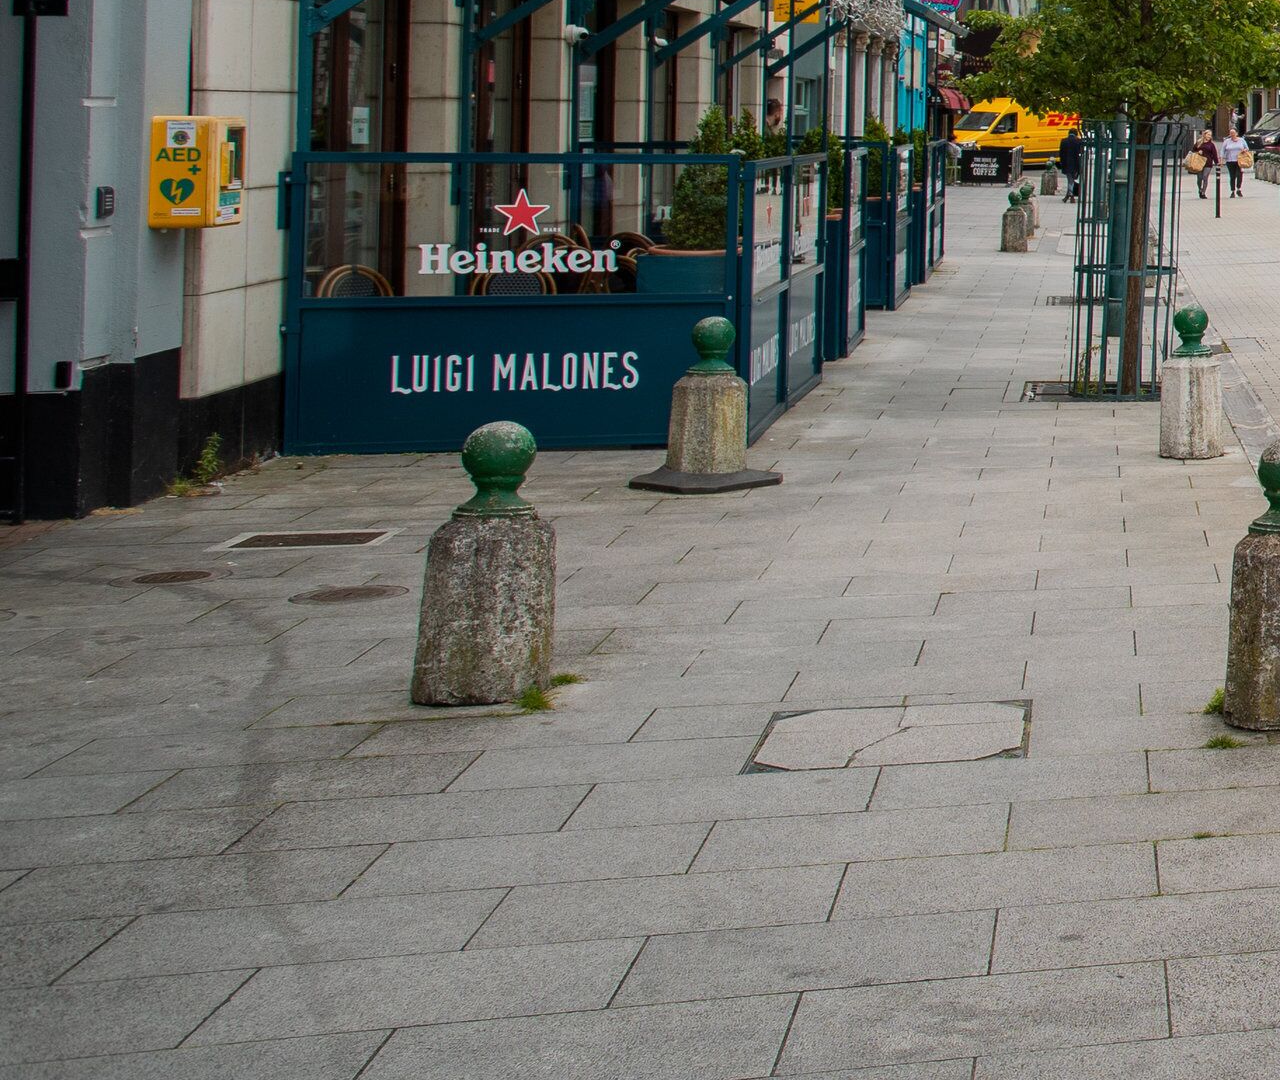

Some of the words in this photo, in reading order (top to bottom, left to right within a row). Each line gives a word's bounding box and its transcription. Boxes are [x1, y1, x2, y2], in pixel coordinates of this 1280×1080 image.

[155, 147, 201, 162] AED
[417, 241, 619, 275] Heineken
[390, 353, 475, 395] LUIGI
[491, 350, 640, 392] MALONES
